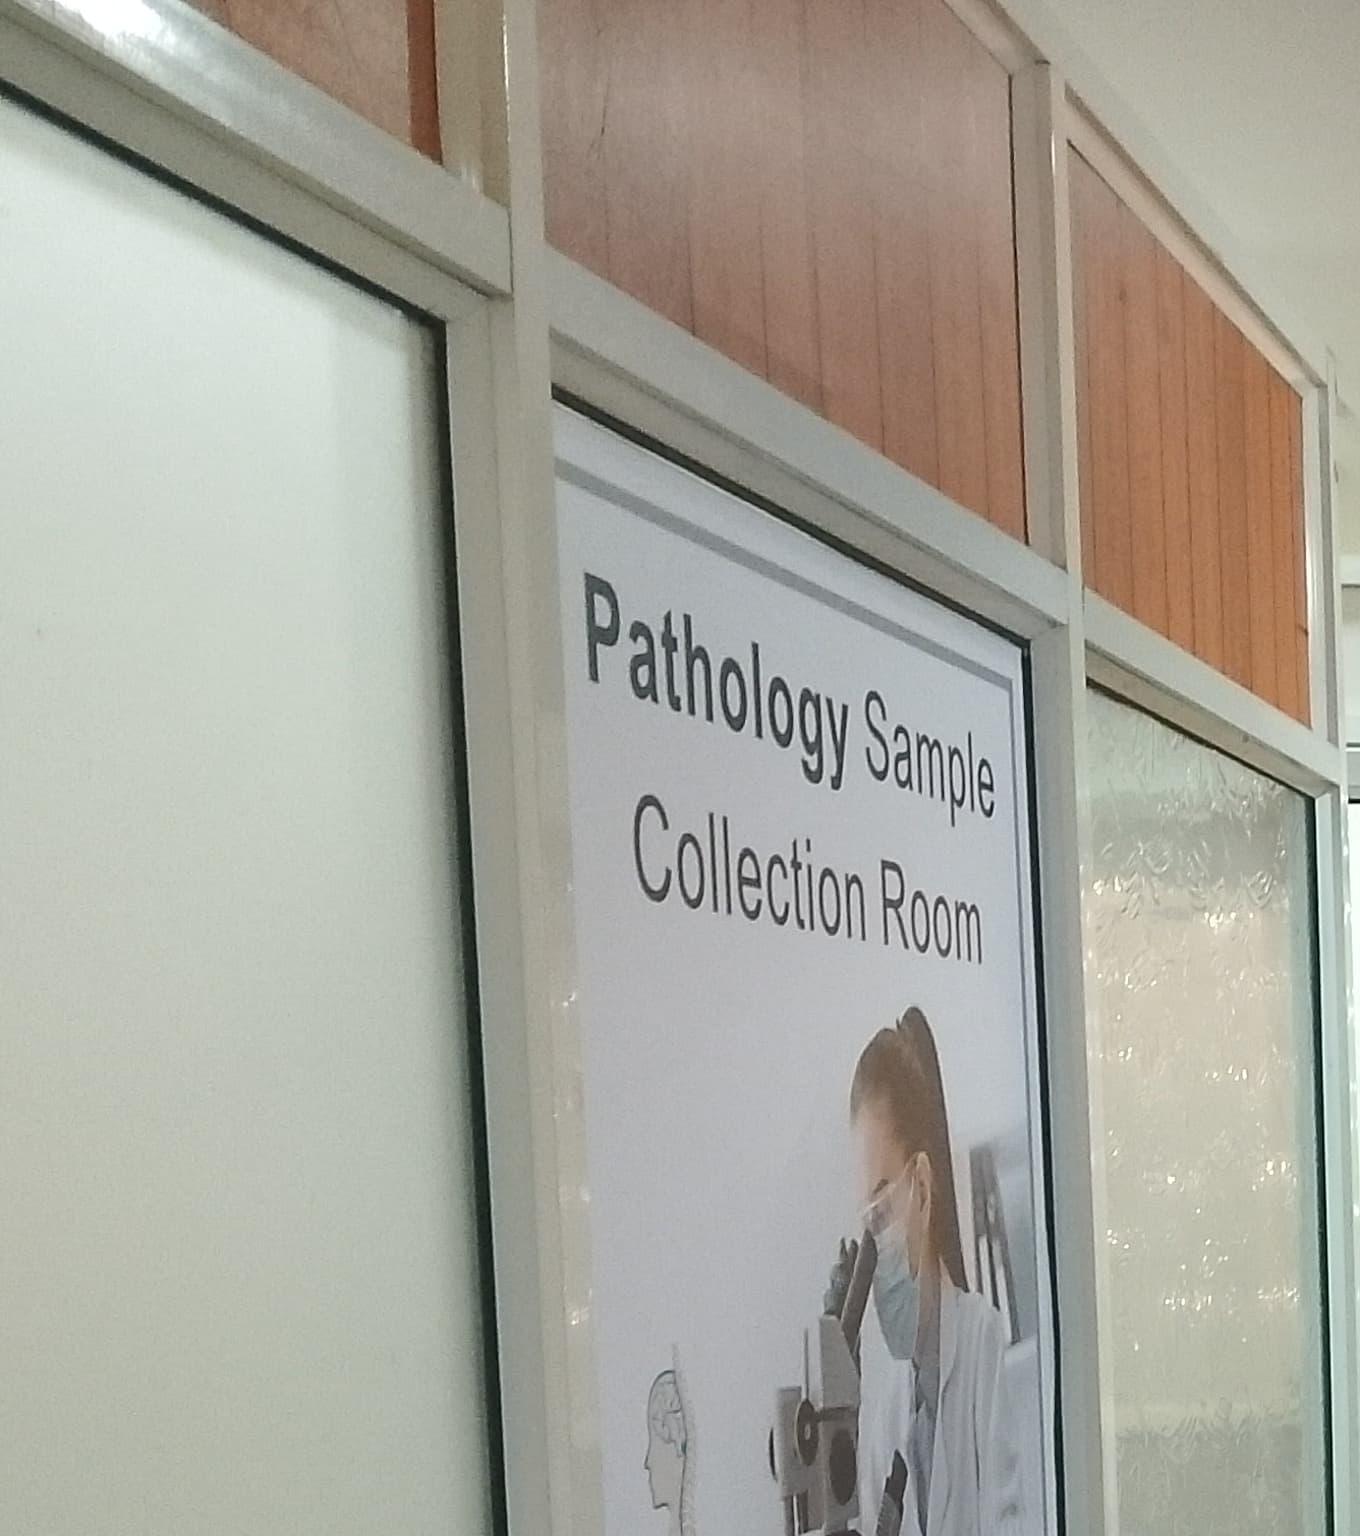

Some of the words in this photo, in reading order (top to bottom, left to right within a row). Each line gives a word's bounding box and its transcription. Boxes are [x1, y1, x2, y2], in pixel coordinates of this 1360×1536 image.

[584, 572, 849, 791] Pathology
[865, 690, 996, 827] Sample
[633, 794, 867, 941] Collection
[881, 859, 983, 964] Room
